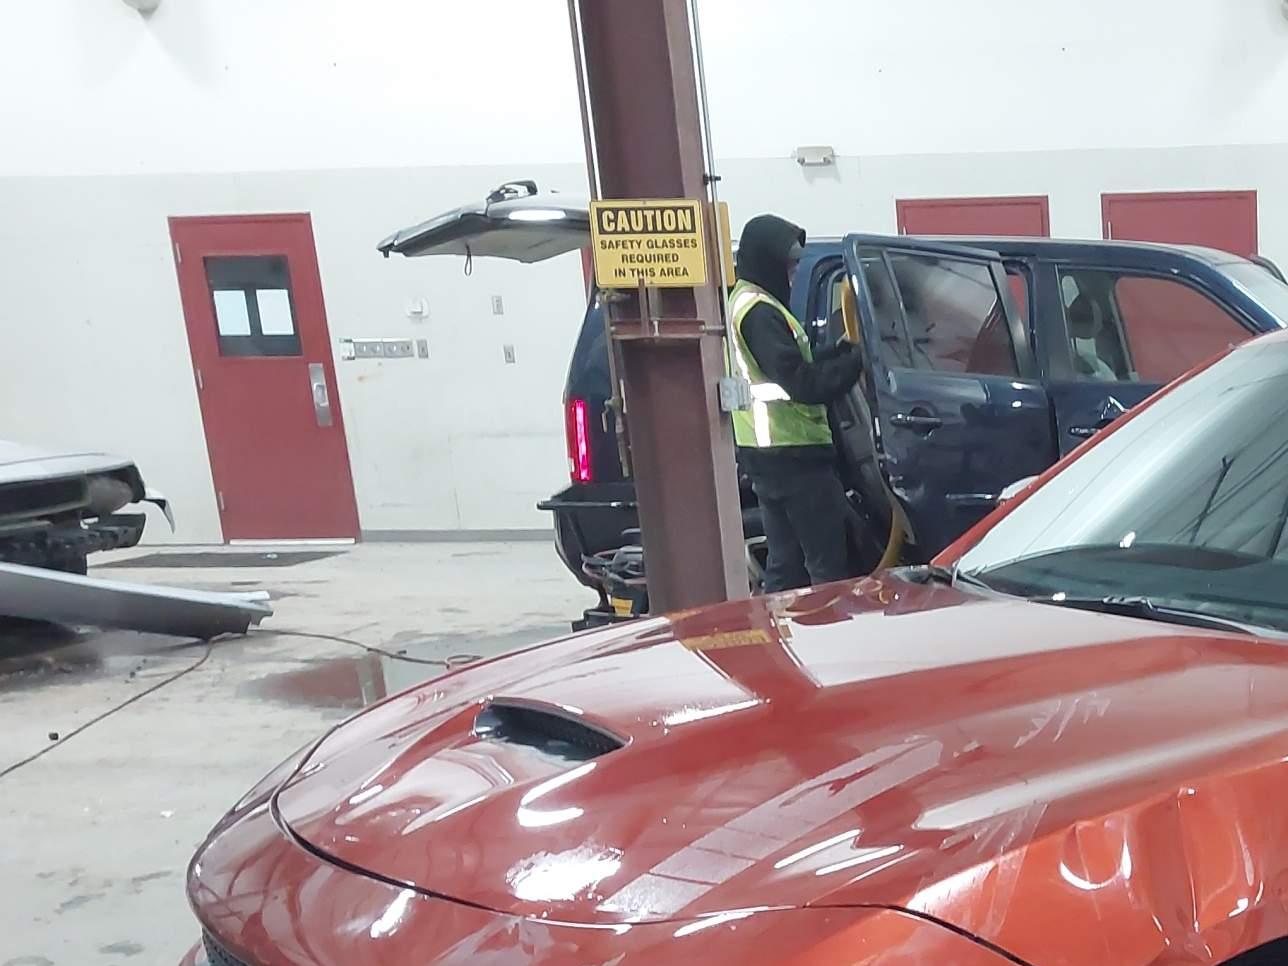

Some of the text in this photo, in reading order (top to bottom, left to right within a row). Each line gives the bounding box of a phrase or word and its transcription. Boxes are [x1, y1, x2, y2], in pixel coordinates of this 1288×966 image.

[602, 209, 692, 232] CAUTION
[600, 238, 698, 249] SAFETY GLASSES
[621, 253, 679, 263] REQUIRED
[614, 267, 689, 278] IN THIS AREA
